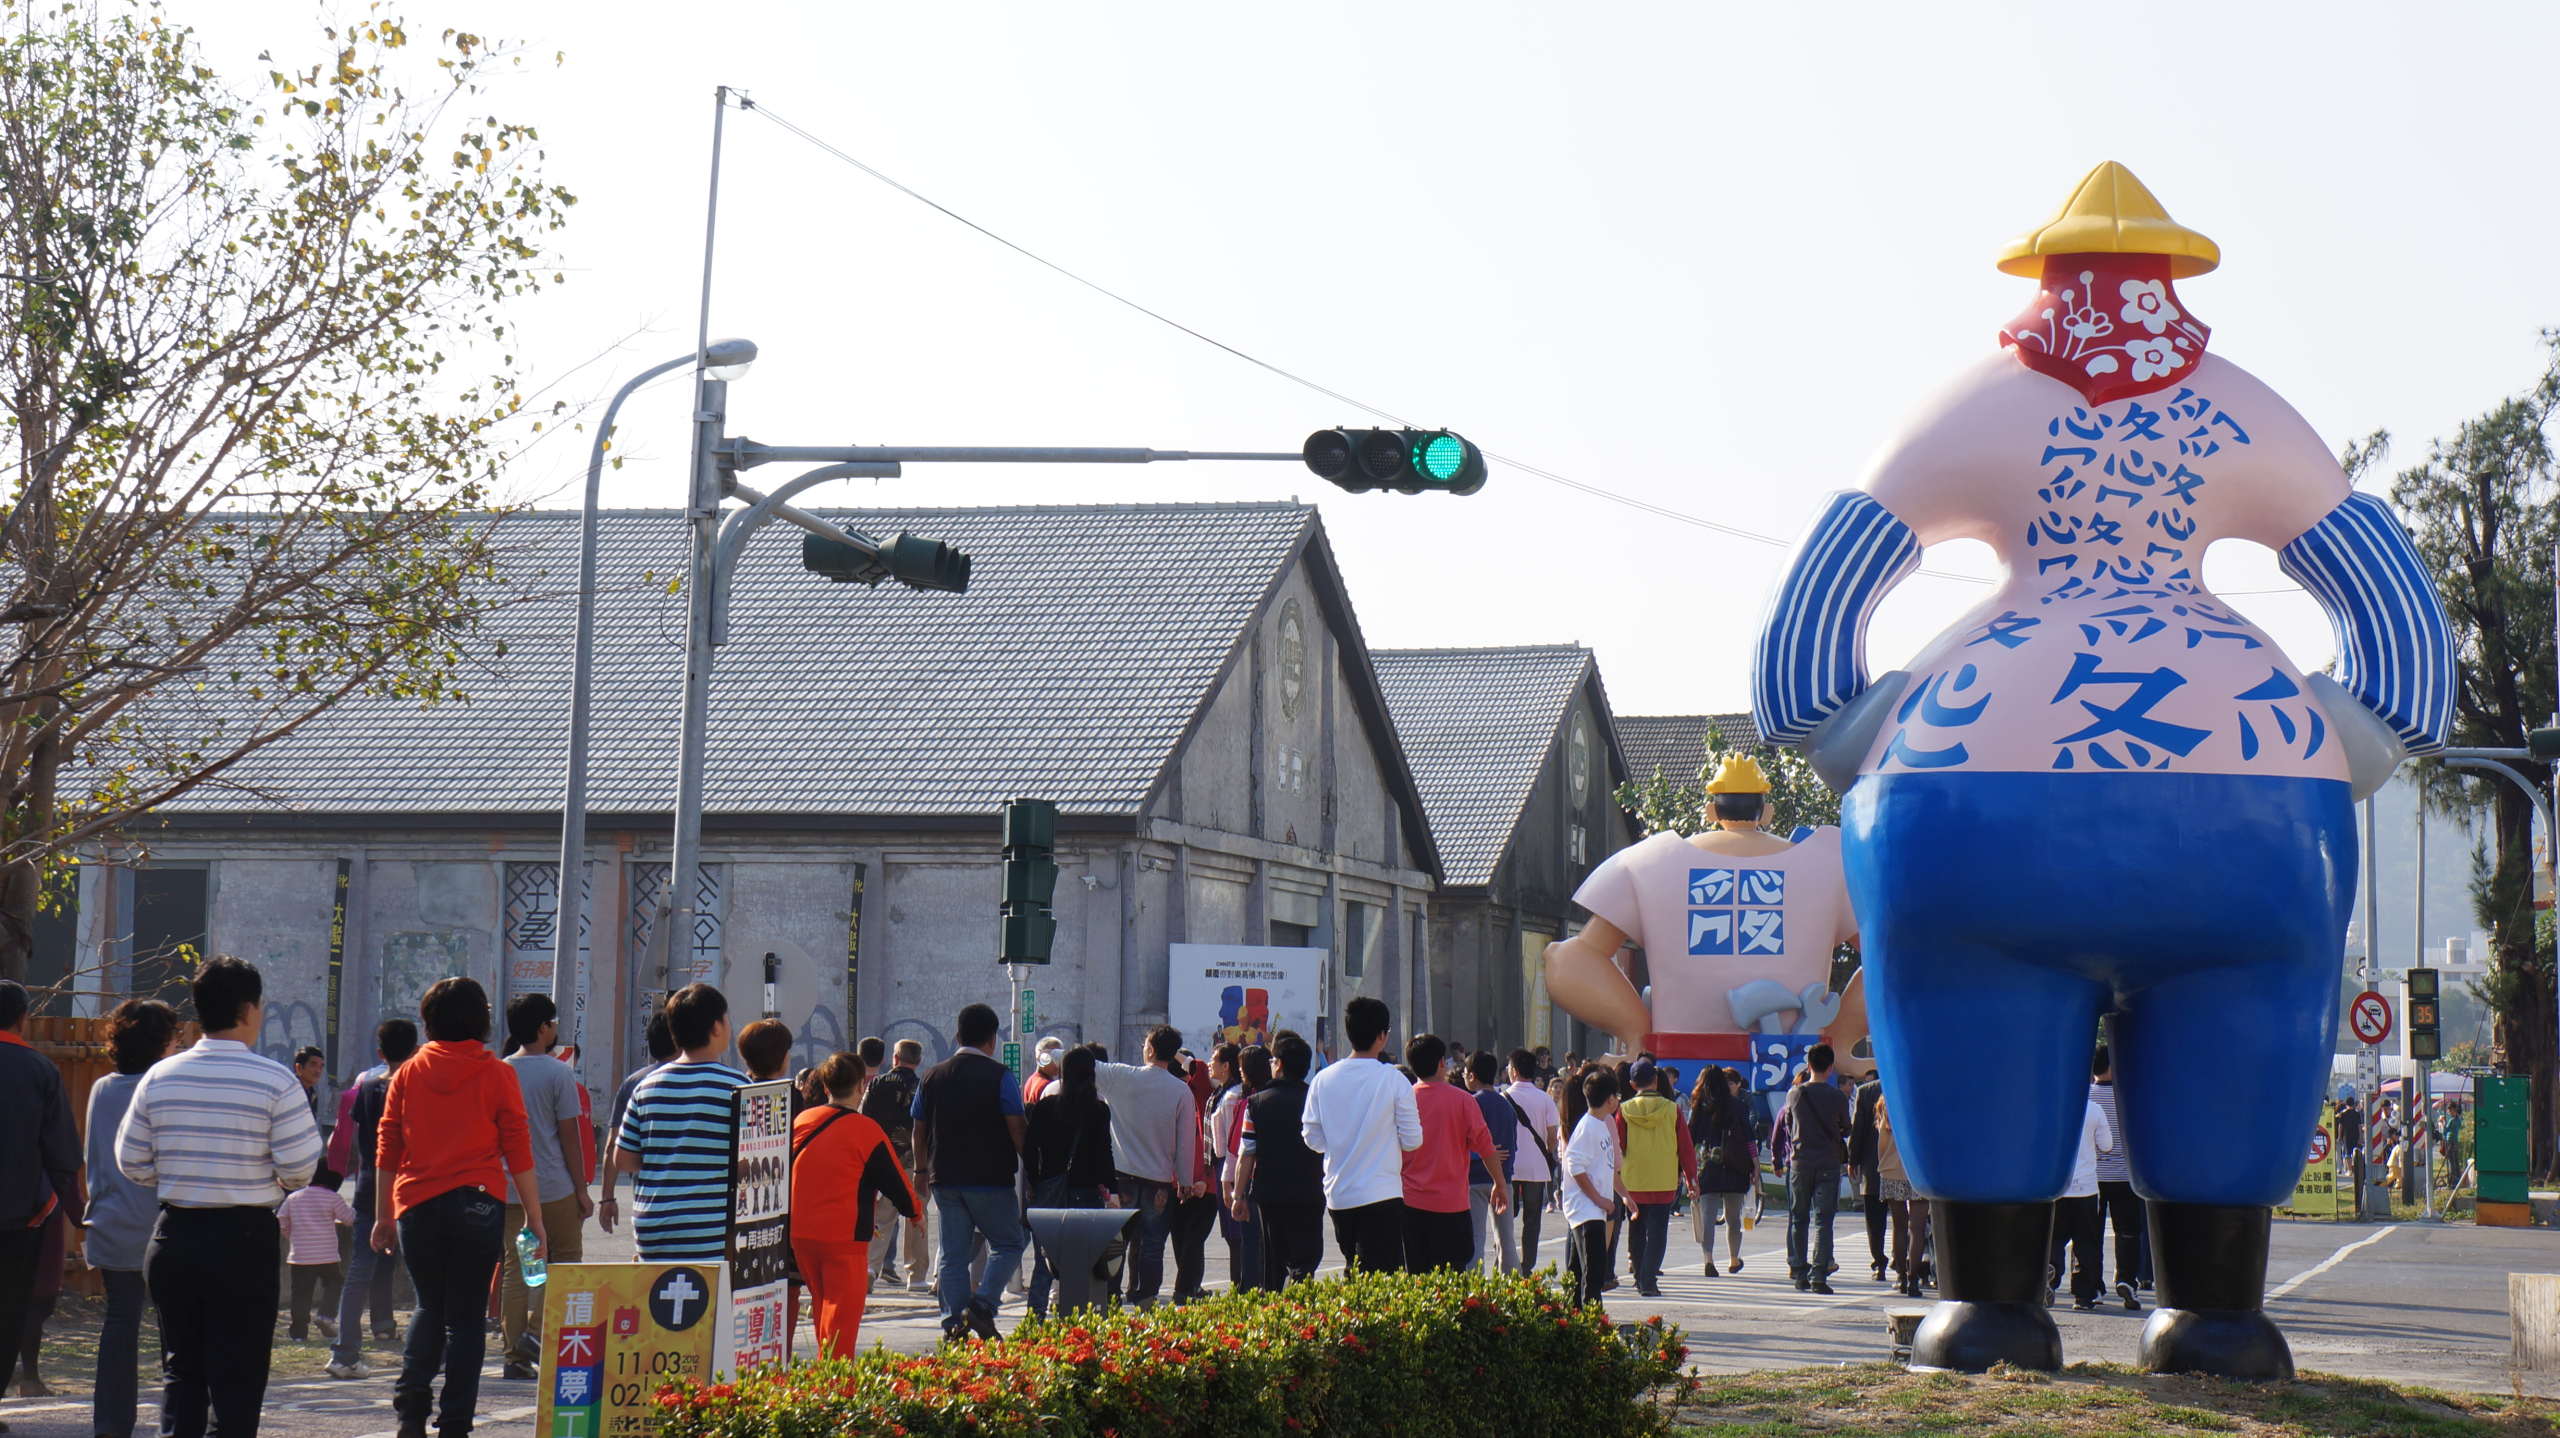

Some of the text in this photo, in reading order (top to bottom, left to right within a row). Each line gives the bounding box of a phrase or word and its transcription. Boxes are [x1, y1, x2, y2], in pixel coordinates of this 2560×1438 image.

[2417, 1006, 2433, 1023] 35
[2301, 1172, 2332, 1181] 止設攤
[617, 1351, 681, 1375] 11.03
[682, 1354, 700, 1364] 2012
[681, 1365, 698, 1375] SAT
